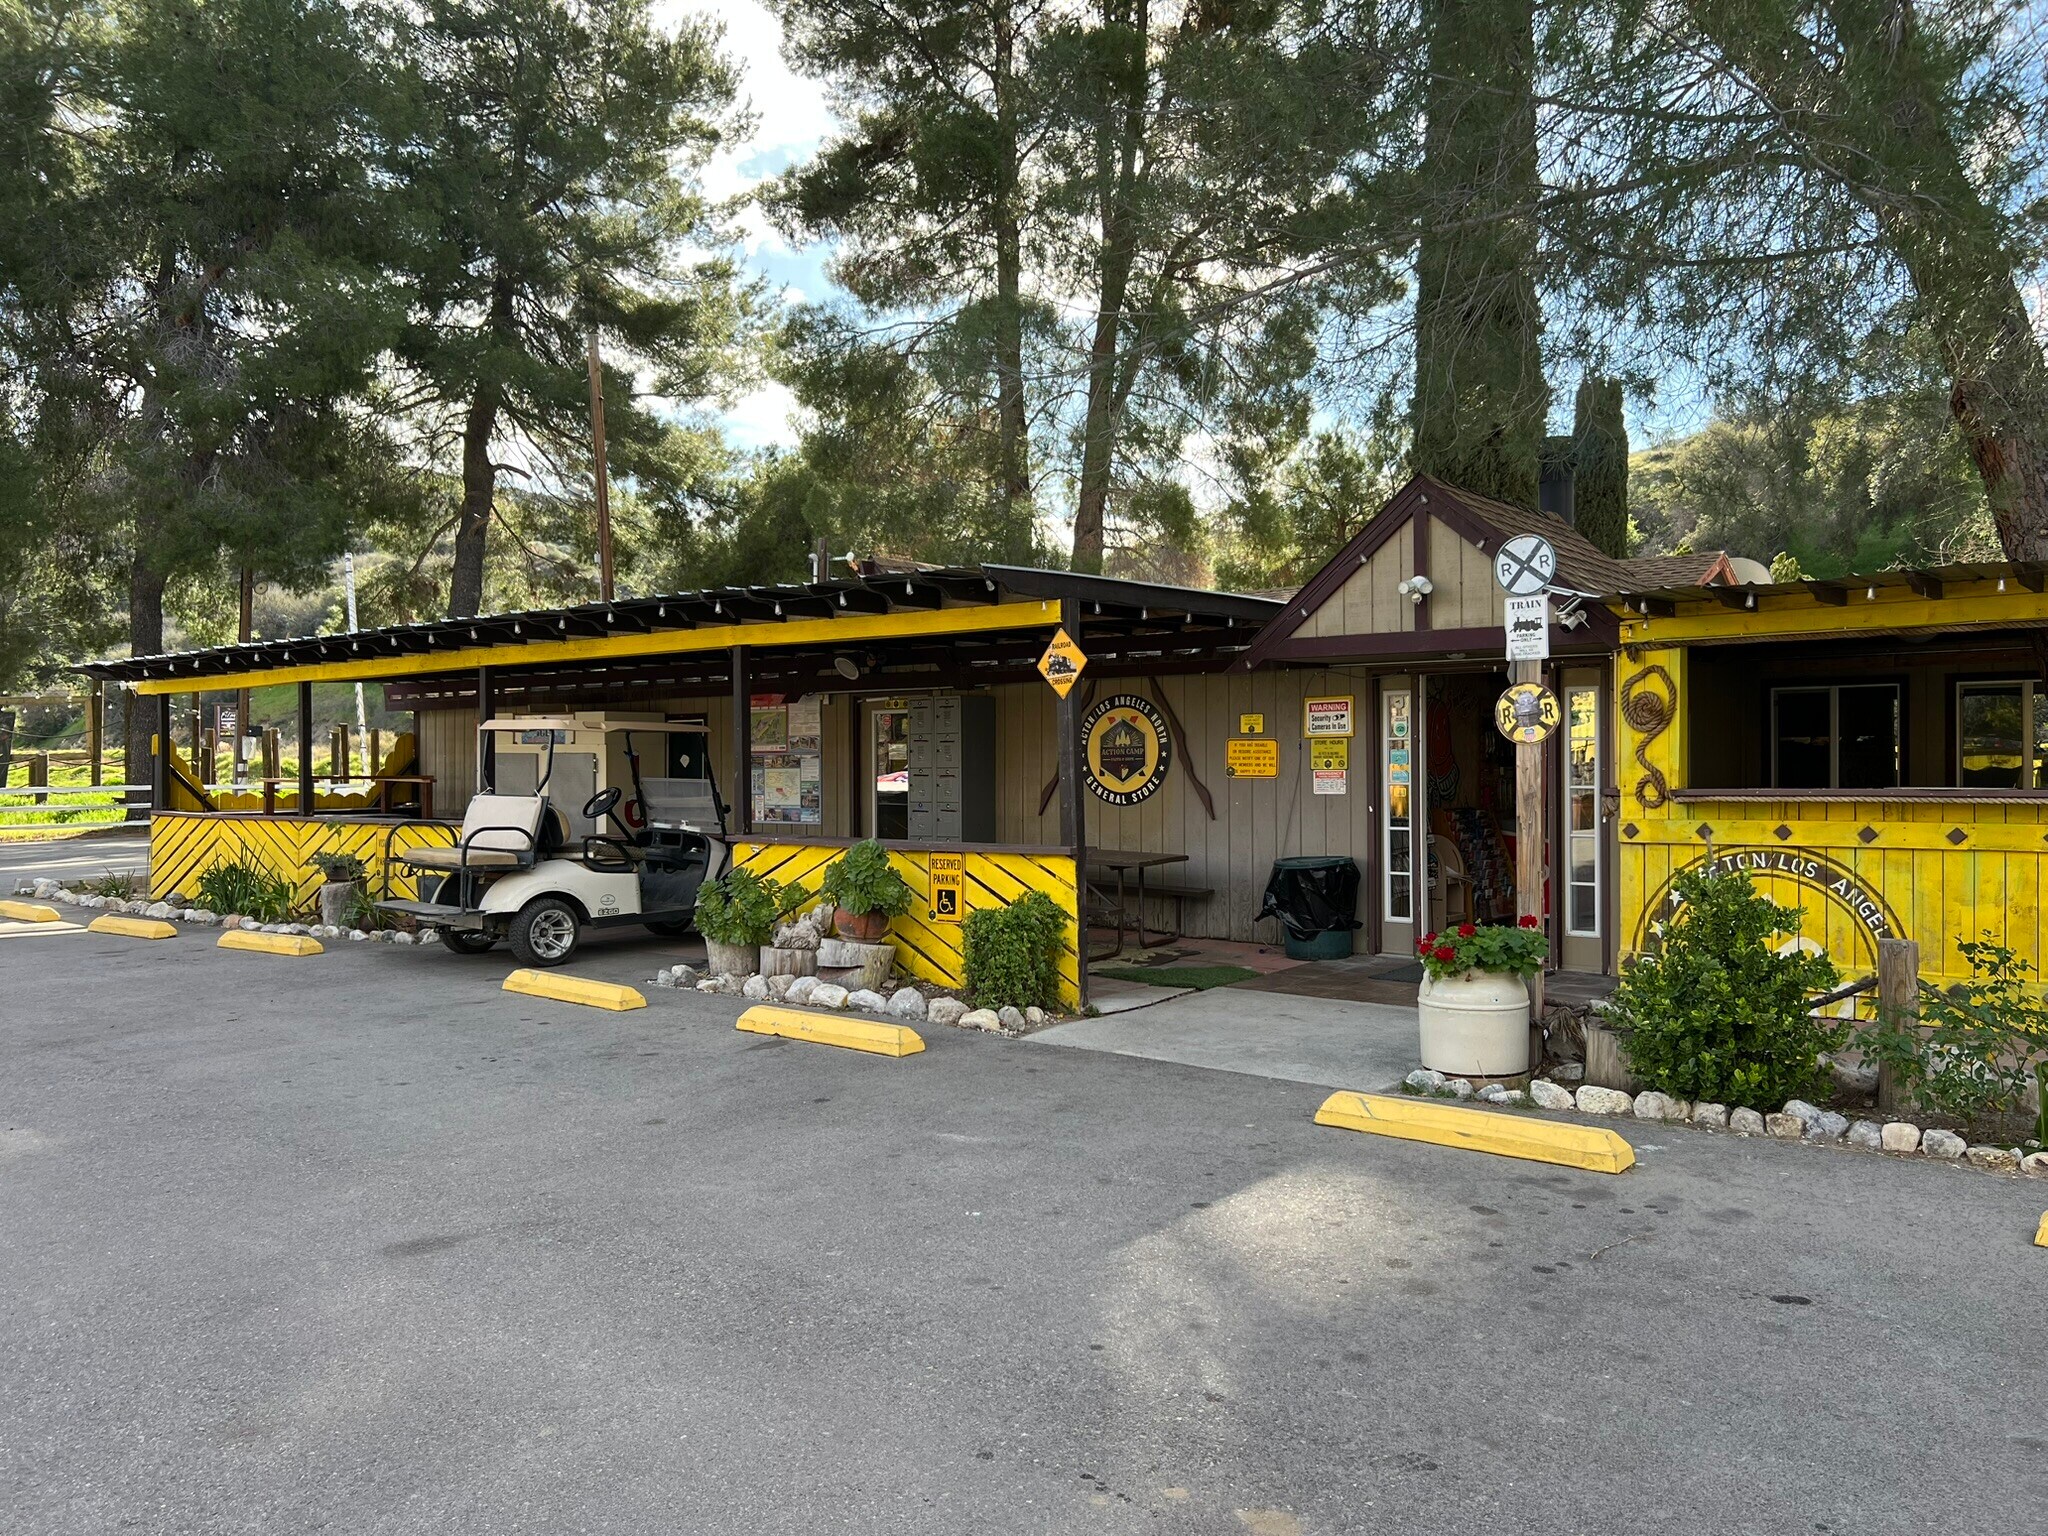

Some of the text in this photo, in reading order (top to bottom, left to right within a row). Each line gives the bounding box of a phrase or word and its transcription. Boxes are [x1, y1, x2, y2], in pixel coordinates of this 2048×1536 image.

[1501, 554, 1551, 577] R R
[1510, 599, 1542, 610] TRAIN
[1051, 641, 1071, 650] RAILROAD
[1052, 677, 1073, 686] CROSSING
[1310, 703, 1347, 711] WARNING
[1502, 702, 1554, 724] R R
[1114, 696, 1151, 714] ANGELES
[1150, 713, 1168, 744] NORTH
[1311, 714, 1331, 722] Security
[1086, 776, 1160, 804] GENERAL STORE
[931, 858, 962, 870] RESERVED
[933, 873, 960, 886] PARKING
[1829, 878, 1889, 941] ANGEL
